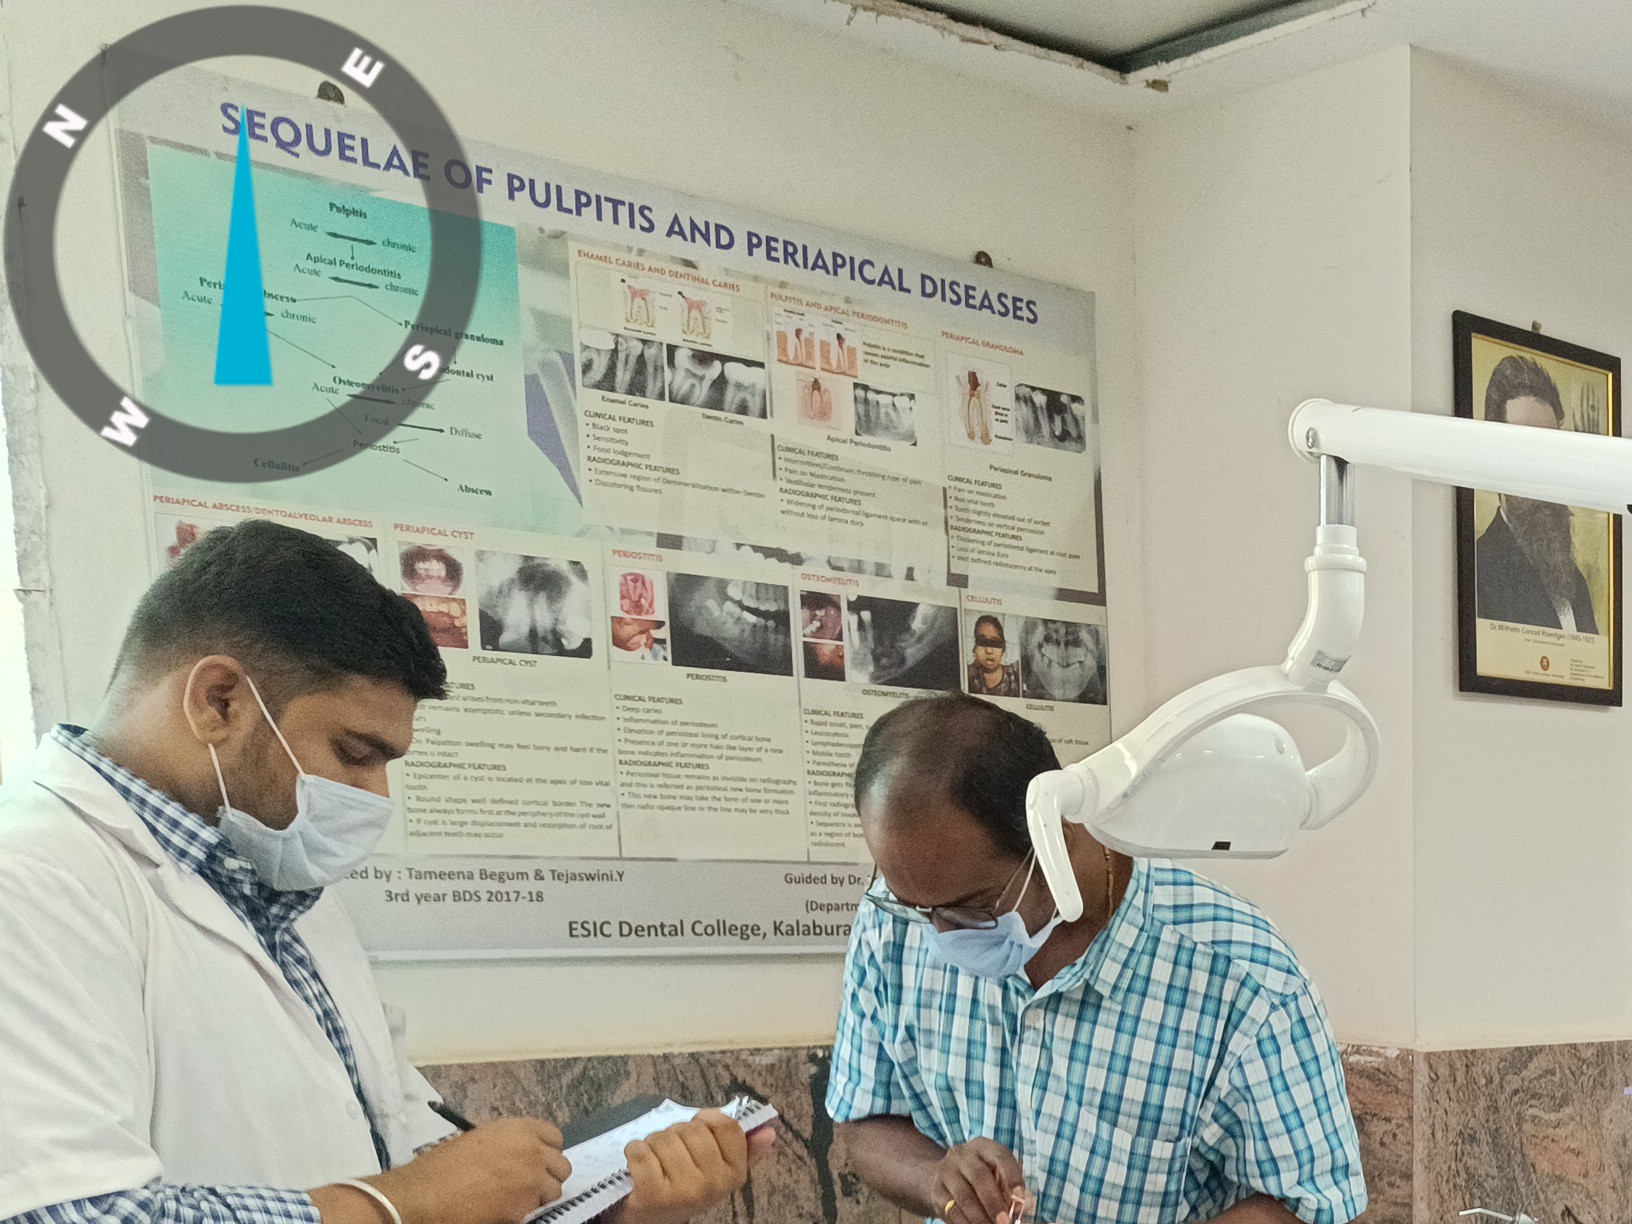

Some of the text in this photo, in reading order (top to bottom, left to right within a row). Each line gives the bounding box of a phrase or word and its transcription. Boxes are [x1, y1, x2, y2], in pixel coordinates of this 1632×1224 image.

[219, 101, 1040, 325] SEQUELAE OF PULPITIS AND PERIAPICAL DISEASES
[290, 217, 417, 253] Acute chronic
[305, 252, 402, 279] Apical Periodontitis
[577, 250, 741, 293] ENAMEL CARIES AND DENTINAL CARIES
[293, 263, 420, 296] Acute chronic
[181, 290, 317, 324] Acute chronic
[404, 319, 504, 346] Periapical granuloma
[941, 330, 980, 347] PERIAPICAL
[311, 382, 340, 396] Acute
[332, 375, 400, 395] Osteomyelitis
[364, 413, 483, 440] Focal Diffuse
[584, 410, 655, 428] CLINICAL FEATURES
[352, 439, 401, 455] Periostitis
[777, 444, 839, 461] CLINICAL FEATURES
[253, 457, 301, 473] Cellulitis
[587, 455, 681, 476] RADIOGRAPHIC FEATURES
[947, 474, 1003, 490] CLINICAL FEATURES
[779, 487, 862, 507] RADIOGRAPHIC FEATURES
[152, 494, 210, 511] PERIAPICAL
[335, 515, 374, 529] ABSCESS
[393, 521, 476, 541] PERIAPICAL CYST
[995, 530, 1023, 542] FEATURES
[800, 570, 860, 588] OSTEOMYELITIS
[1498, 623, 1521, 634] Wilhelm
[1521, 627, 1541, 637] Conrad
[472, 655, 538, 668] PERIAPICAL CYST
[614, 693, 684, 706] CLINICAL FEATURES
[803, 707, 864, 720] CLINICAL FEATURES
[467, 762, 507, 772] FEATURES
[674, 761, 710, 771] FEATURES
[371, 867, 392, 884] by
[406, 866, 475, 882] Tameena
[479, 868, 530, 885] Begum
[533, 868, 546, 882] &
[548, 868, 626, 886] Tejaswini.Y
[784, 872, 865, 889] Guided by Dr.
[384, 889, 545, 906] 3rd year BDS 2017-18
[567, 918, 852, 943] ESIC Dental College, Kalabura
